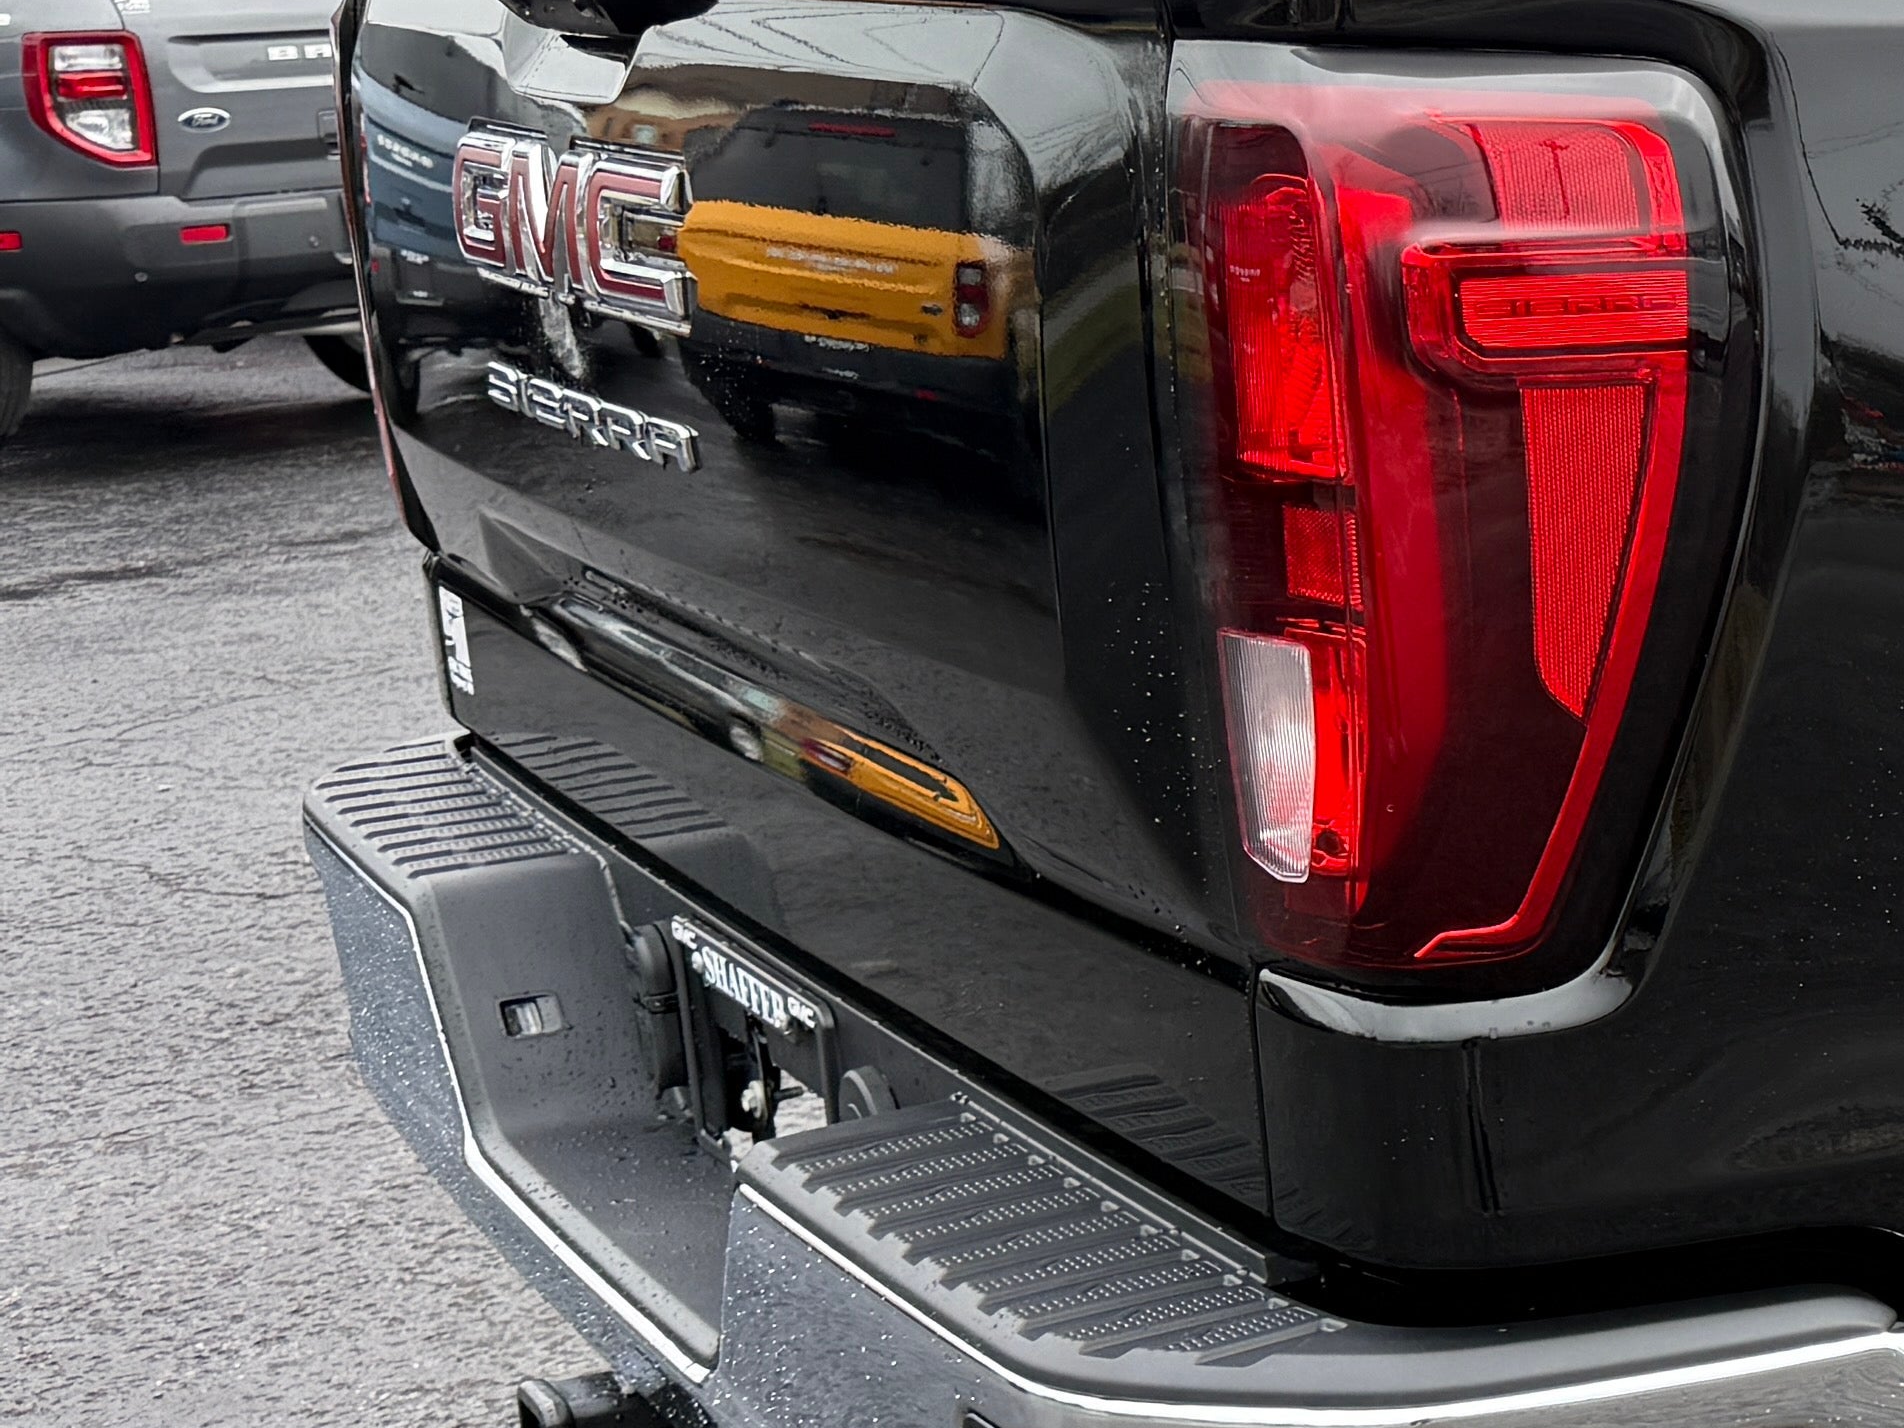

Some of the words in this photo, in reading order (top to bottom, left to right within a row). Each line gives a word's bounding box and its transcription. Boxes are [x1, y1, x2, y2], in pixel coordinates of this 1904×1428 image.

[452, 130, 692, 336] GMC
[487, 360, 700, 473] SIERRA
[701, 945, 790, 1031] SHAFFER
